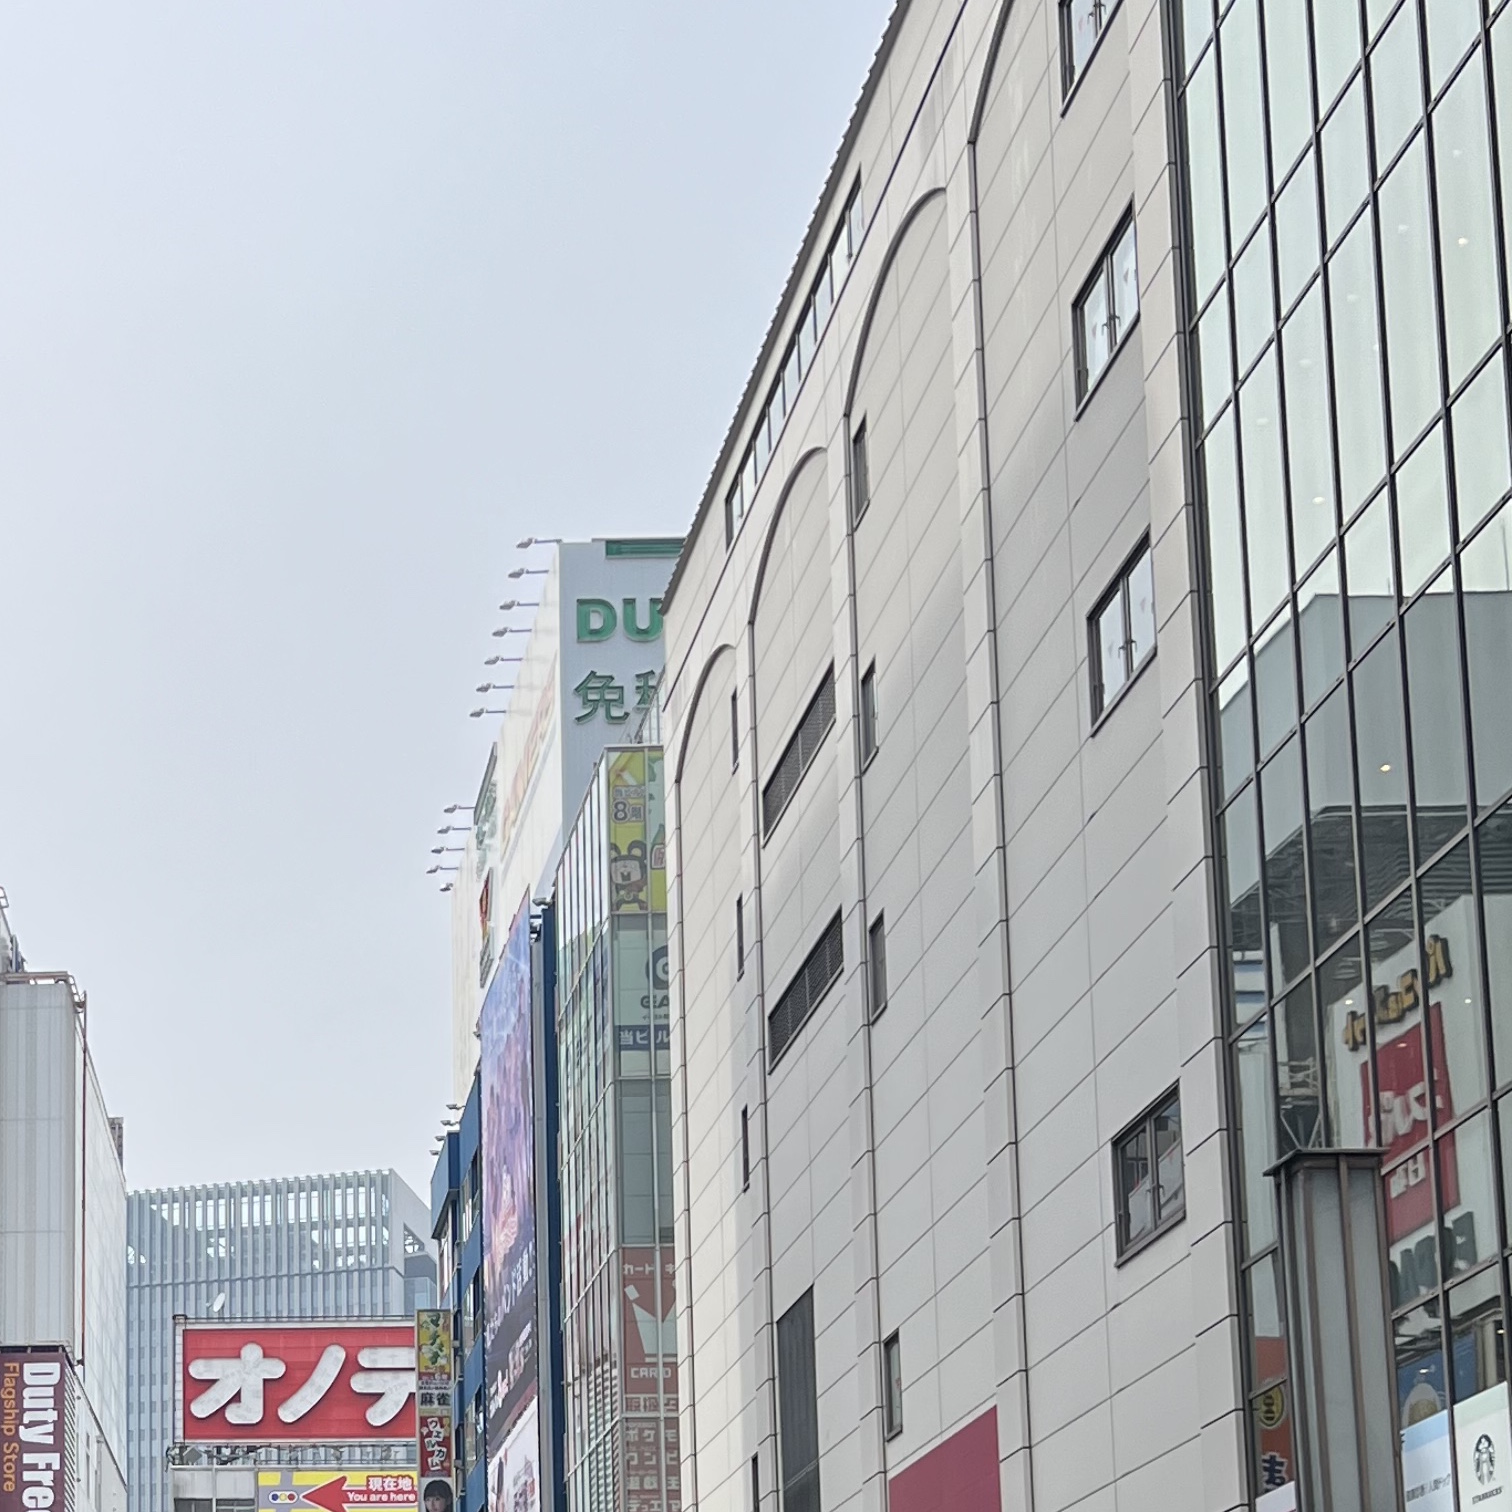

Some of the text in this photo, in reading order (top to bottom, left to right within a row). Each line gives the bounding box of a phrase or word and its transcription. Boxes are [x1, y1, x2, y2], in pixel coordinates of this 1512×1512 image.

[1, 1362, 20, 1493] Flagship Store
[18, 1362, 61, 1445] Duty
[347, 1491, 416, 1502] You are here
